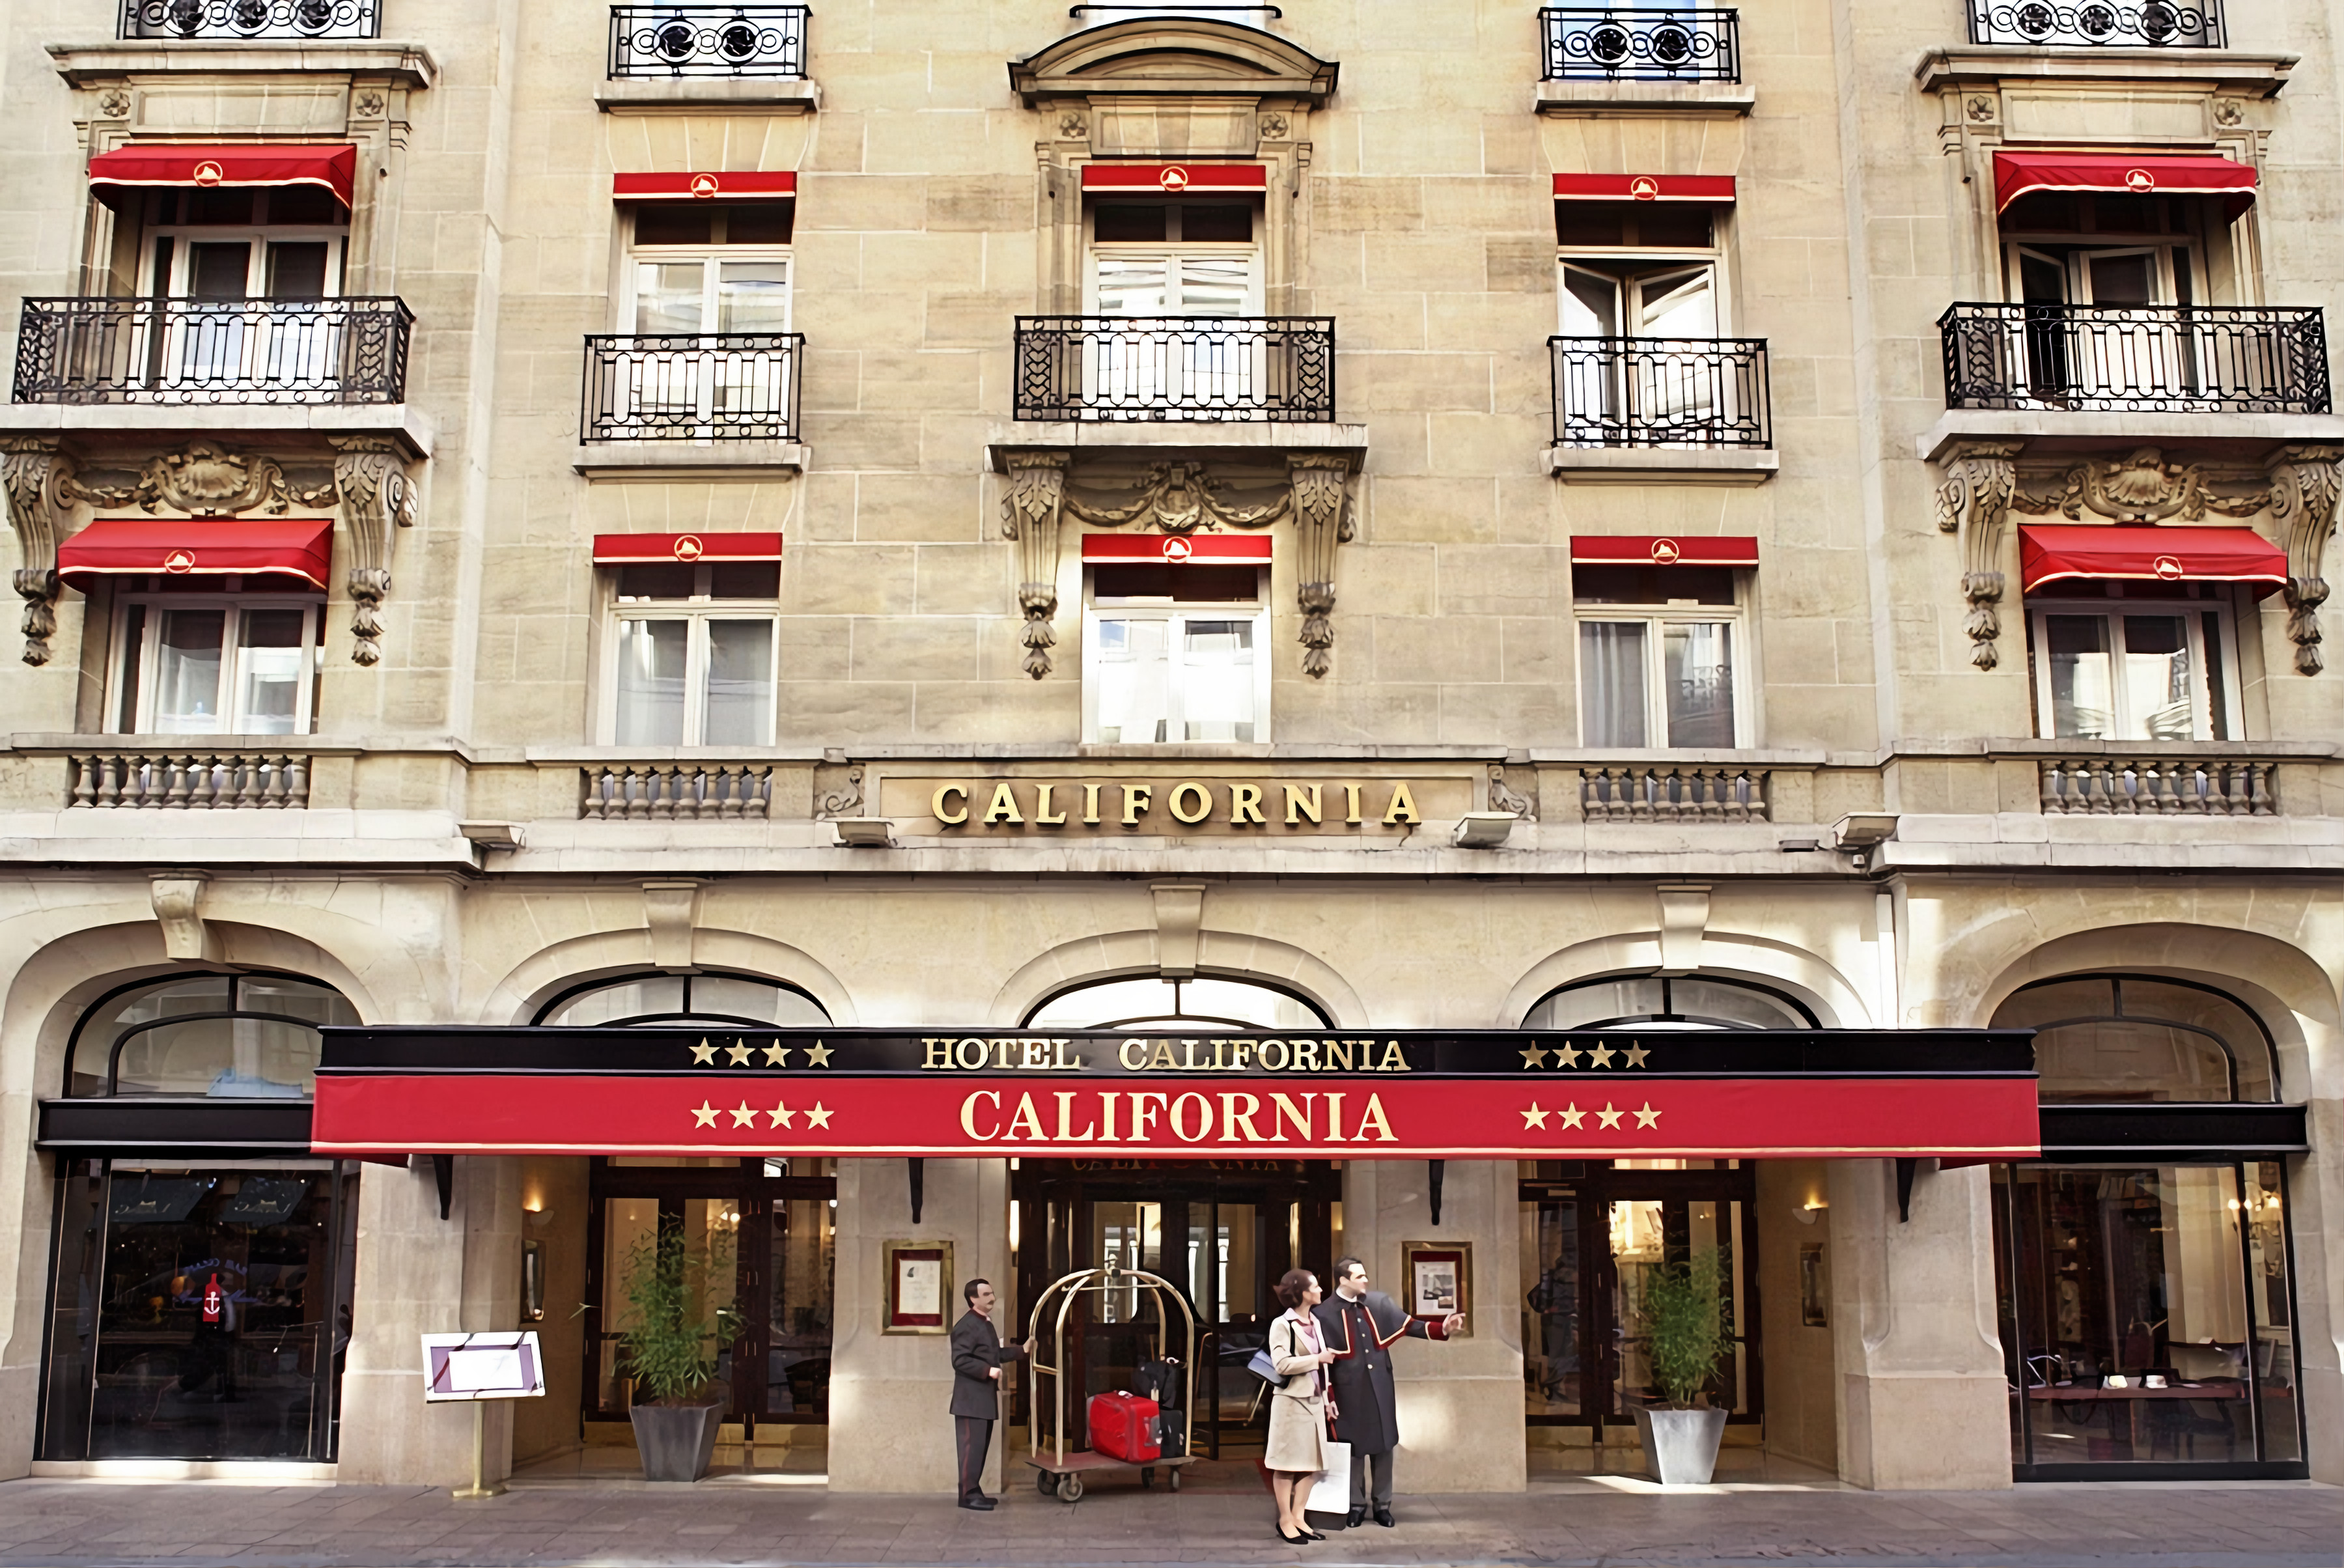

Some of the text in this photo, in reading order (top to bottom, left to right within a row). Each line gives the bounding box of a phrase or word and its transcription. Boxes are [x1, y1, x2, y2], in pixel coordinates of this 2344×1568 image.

[930, 781, 1422, 827] CALIFORNIA
[921, 1038, 1412, 1072] HOTEL CALIFORNIA
[960, 1089, 1399, 1142] CALIFORNIA
